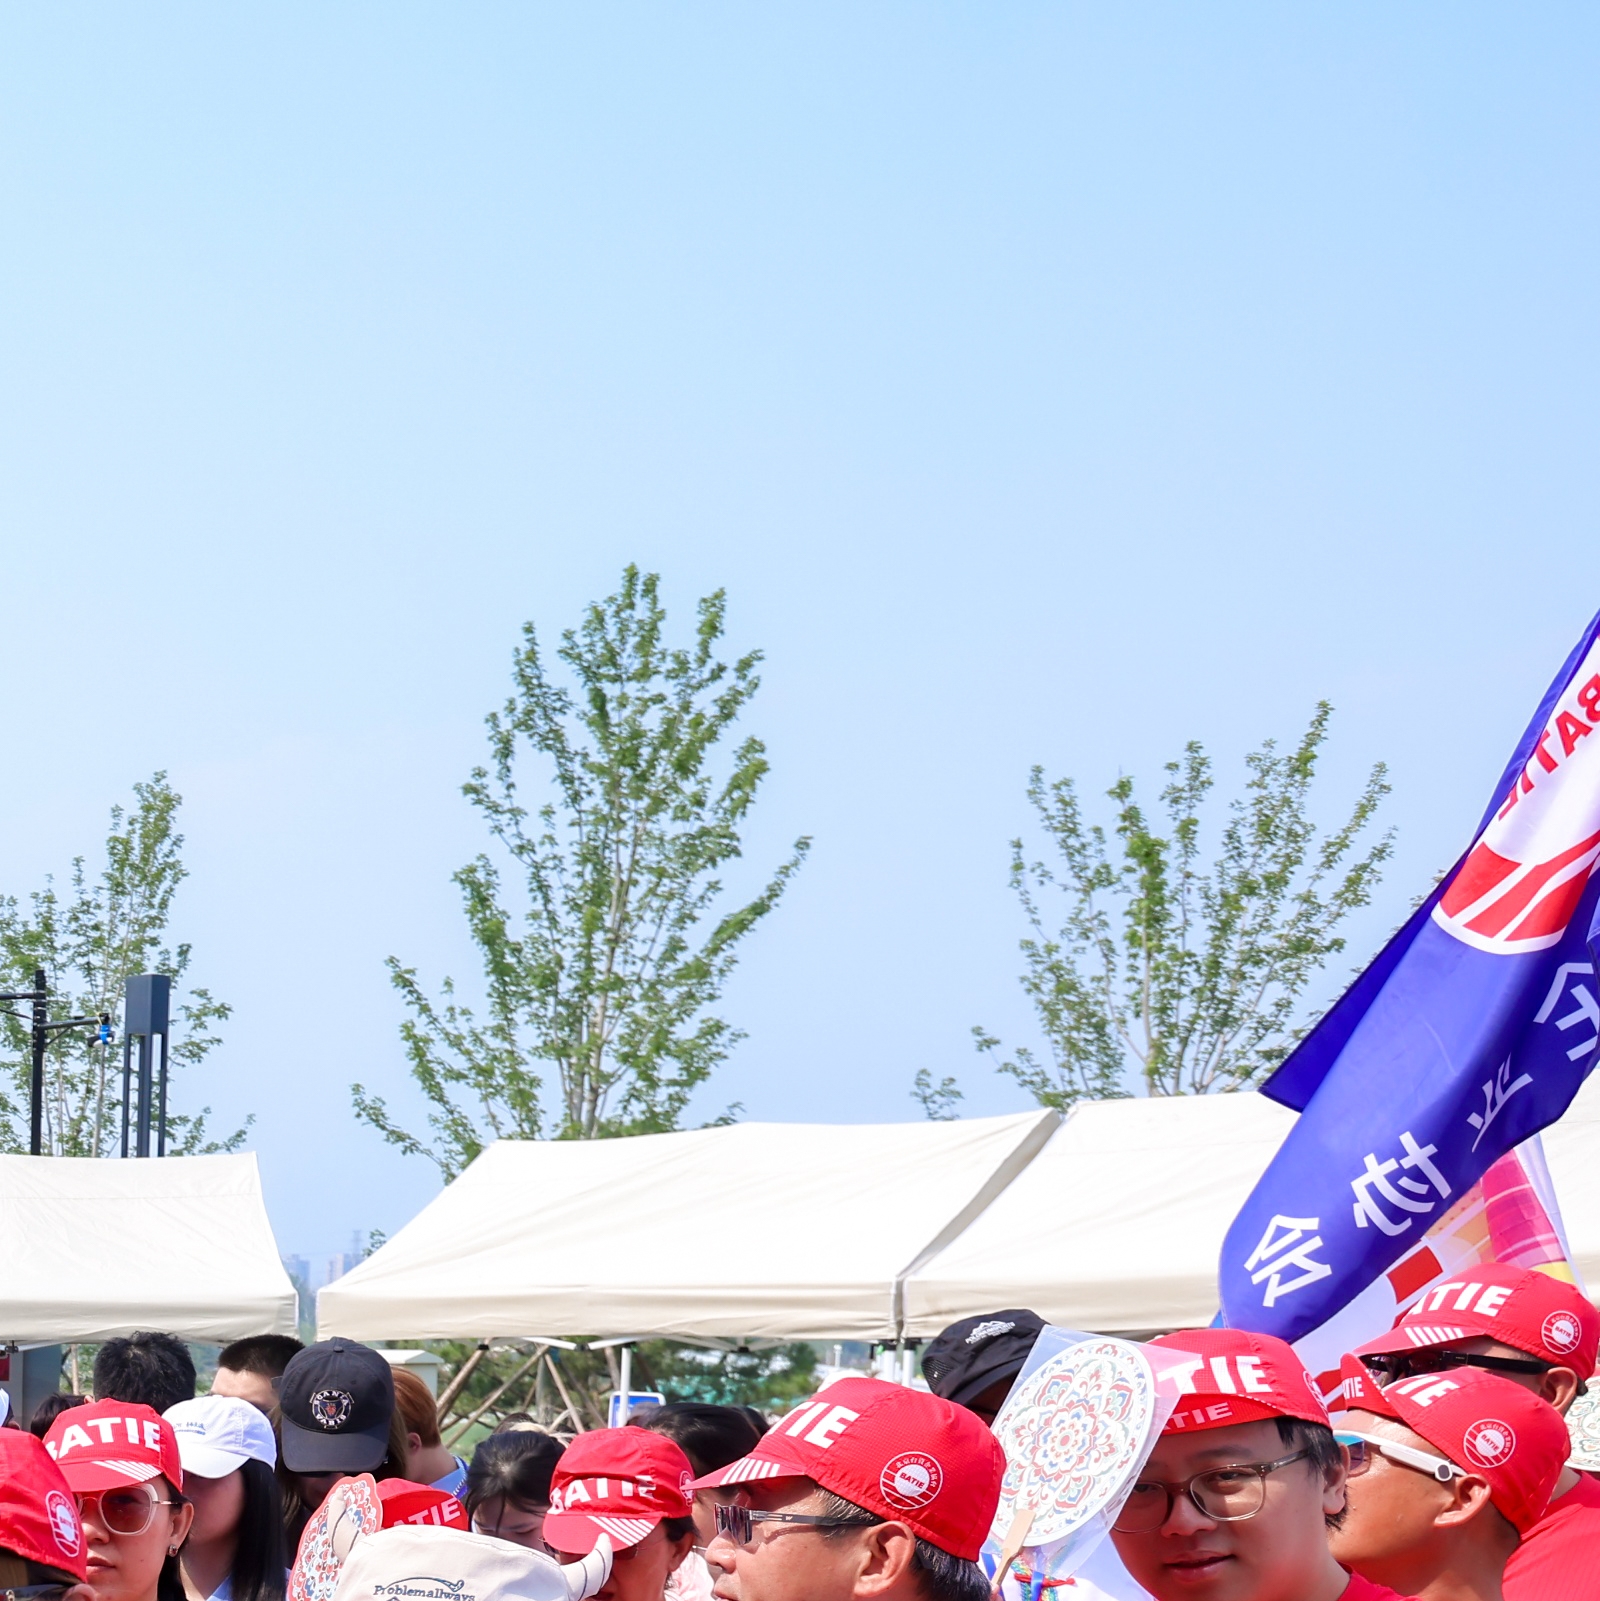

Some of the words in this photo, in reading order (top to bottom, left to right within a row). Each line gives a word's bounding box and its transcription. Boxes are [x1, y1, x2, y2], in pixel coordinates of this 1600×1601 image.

[1157, 1355, 1272, 1394] TIE
[1481, 1434, 1500, 1452] BATIE
[899, 1471, 925, 1489] BATIE
